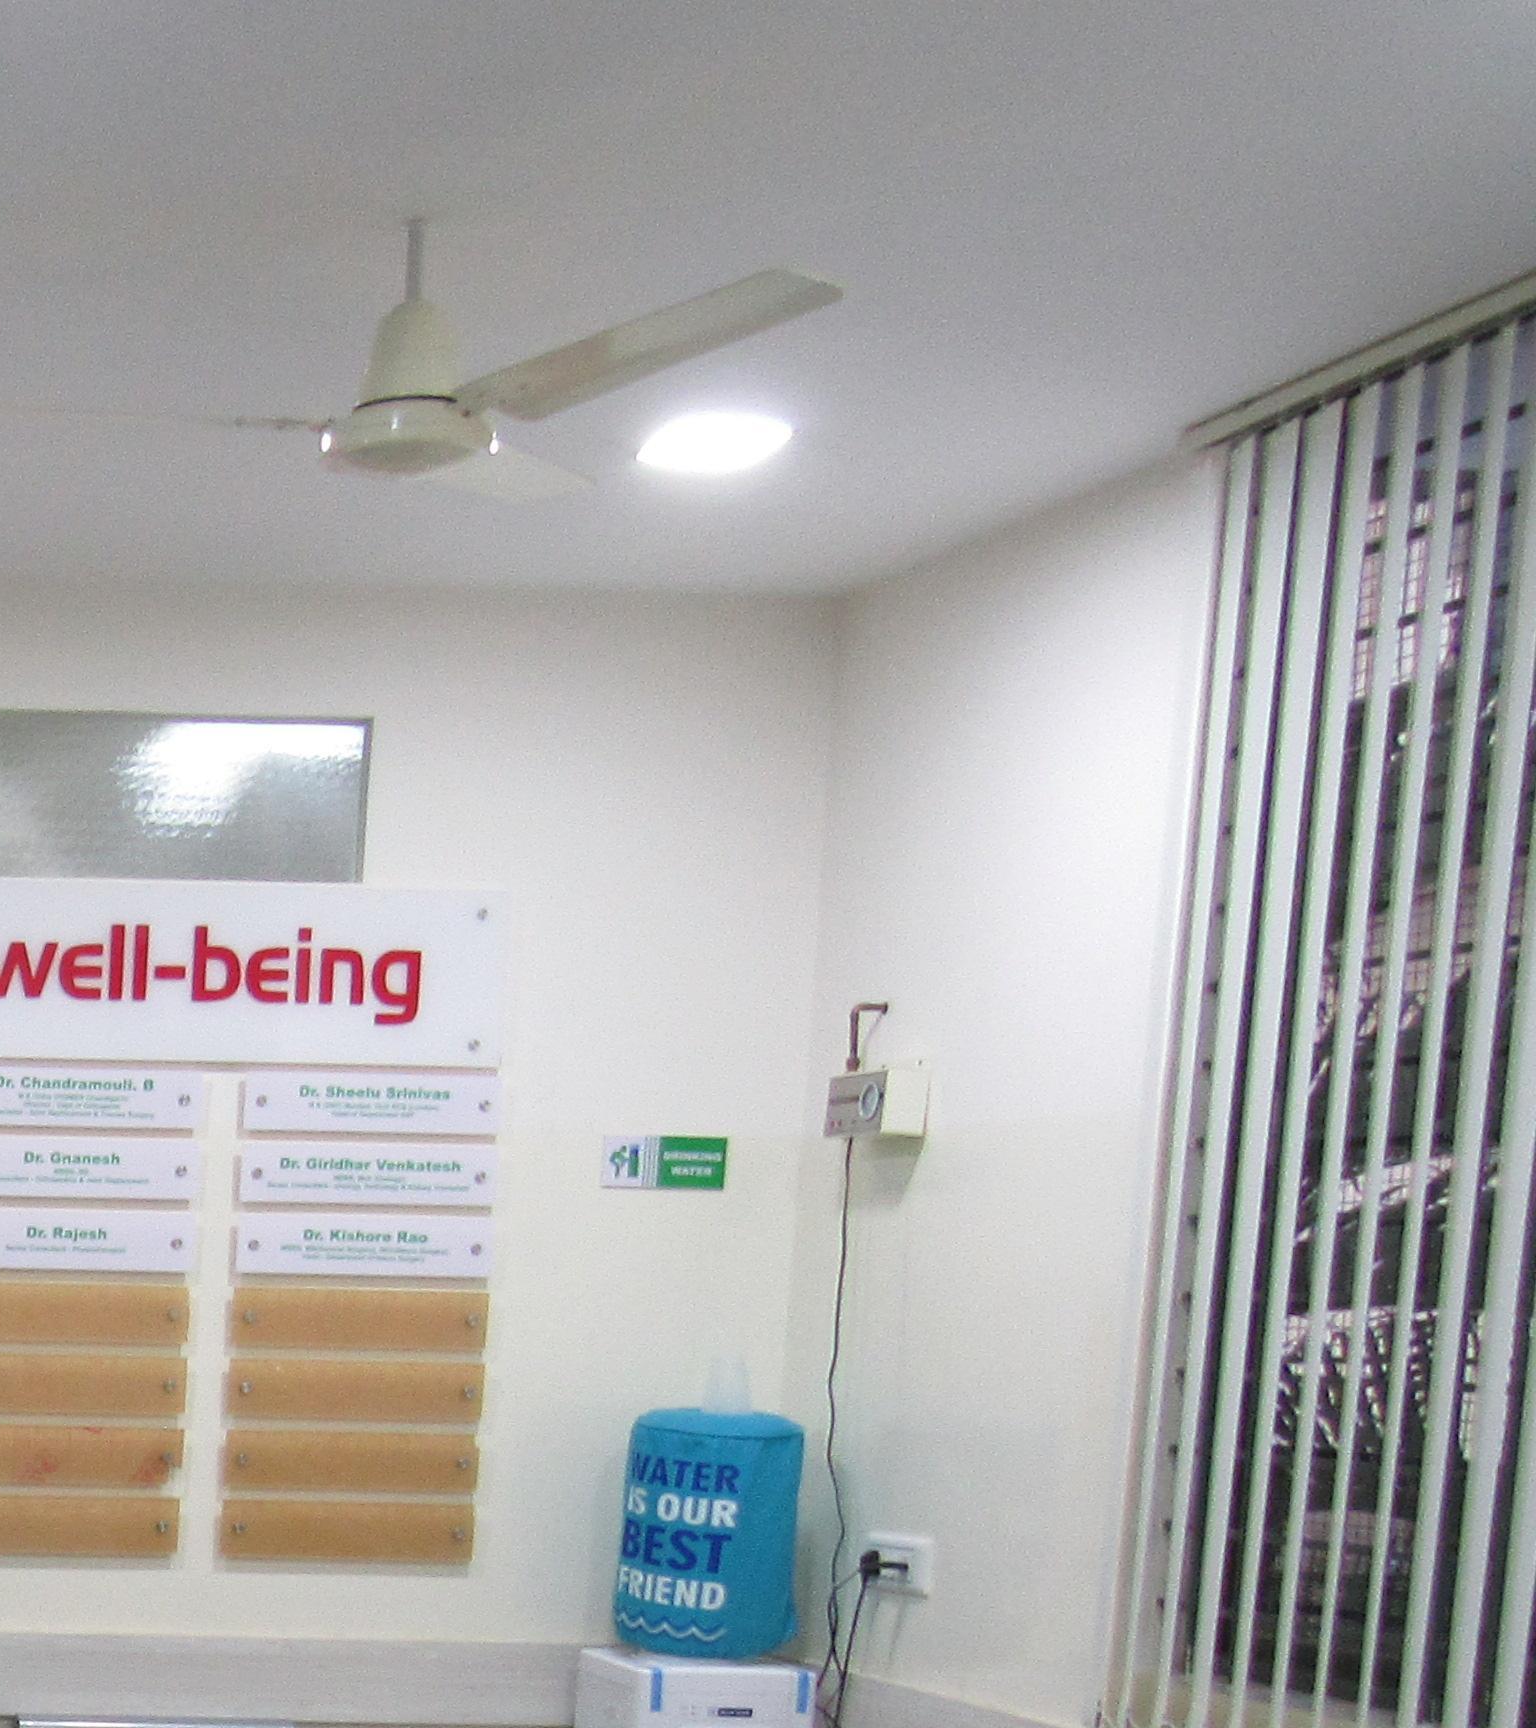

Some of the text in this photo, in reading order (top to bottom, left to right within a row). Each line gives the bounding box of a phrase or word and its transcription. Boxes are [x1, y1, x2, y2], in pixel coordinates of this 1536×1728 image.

[299, 1085, 319, 1097] Dr.
[386, 1087, 450, 1100] Srinivas
[24, 1152, 120, 1164] Dr. Gnanesh
[280, 1158, 461, 1172] Dr. Giridhar Venkatesh
[26, 1227, 107, 1241] Dr. Rajesh
[303, 1230, 428, 1243] Dr. Kishore Rao
[631, 1452, 741, 1495] WATER
[628, 1489, 739, 1529] IS OUR
[622, 1518, 732, 1575] BEST
[618, 1567, 727, 1611] FRIEND
